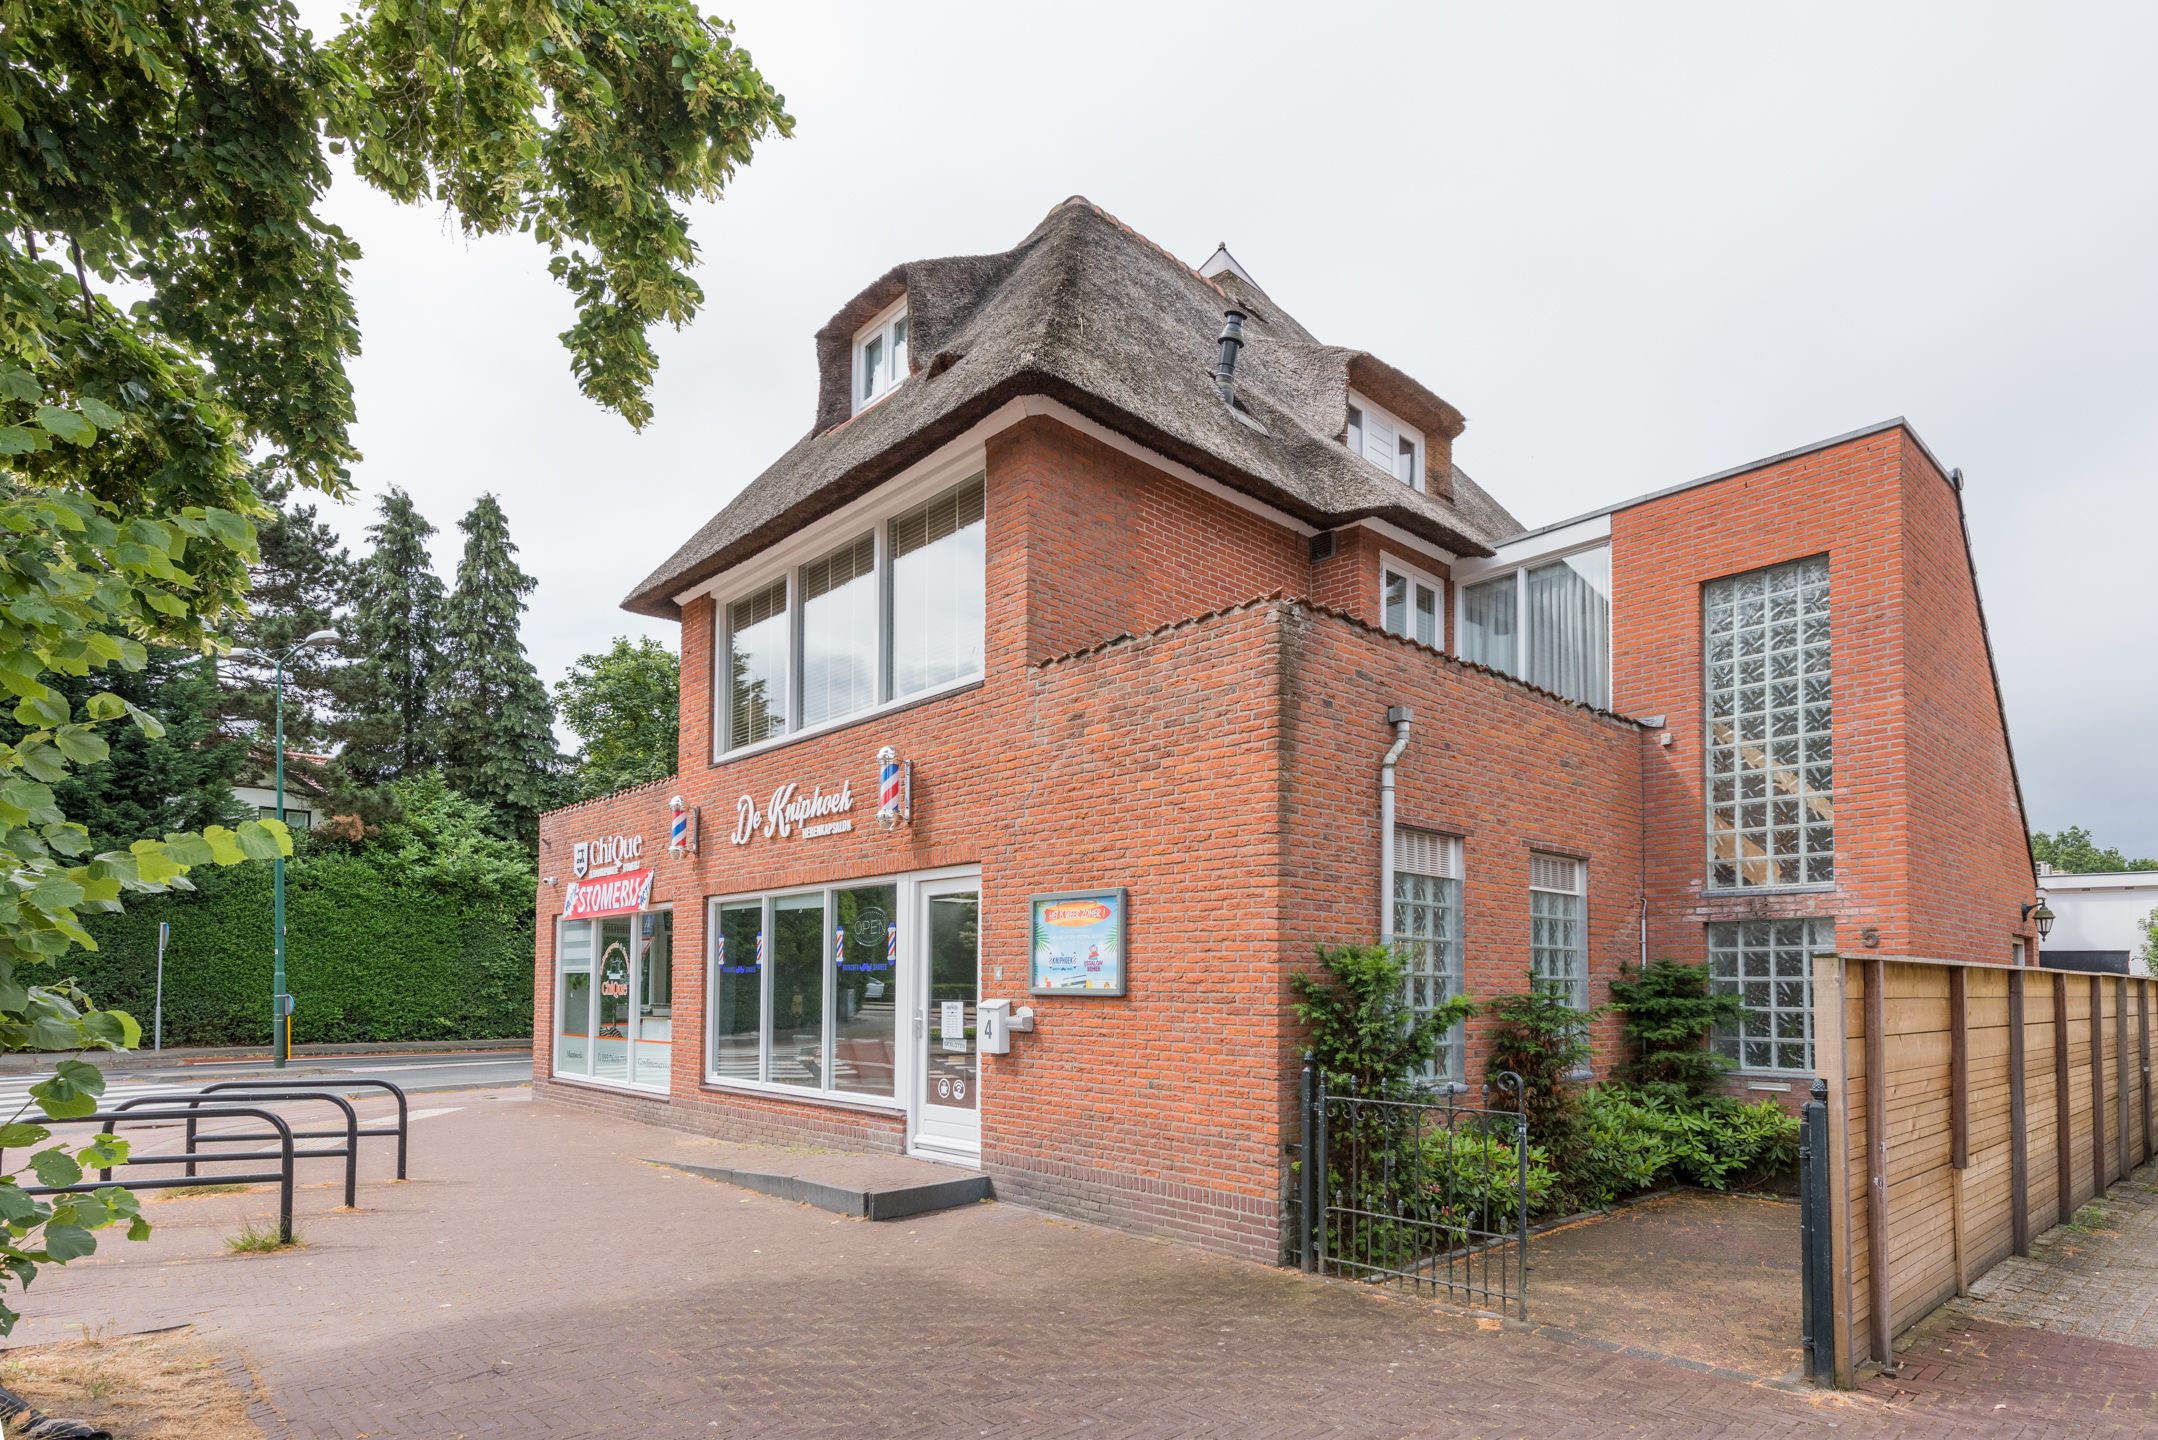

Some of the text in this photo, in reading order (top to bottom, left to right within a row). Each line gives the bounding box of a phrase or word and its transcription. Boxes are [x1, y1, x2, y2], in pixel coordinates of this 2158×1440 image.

[731, 779, 853, 844] De Kniphoek
[590, 835, 642, 868] ChiQue
[577, 878, 641, 913] STOMERIJ
[854, 920, 886, 935] OPEN
[1861, 927, 1879, 949] 5
[984, 1019, 993, 1039] 4
